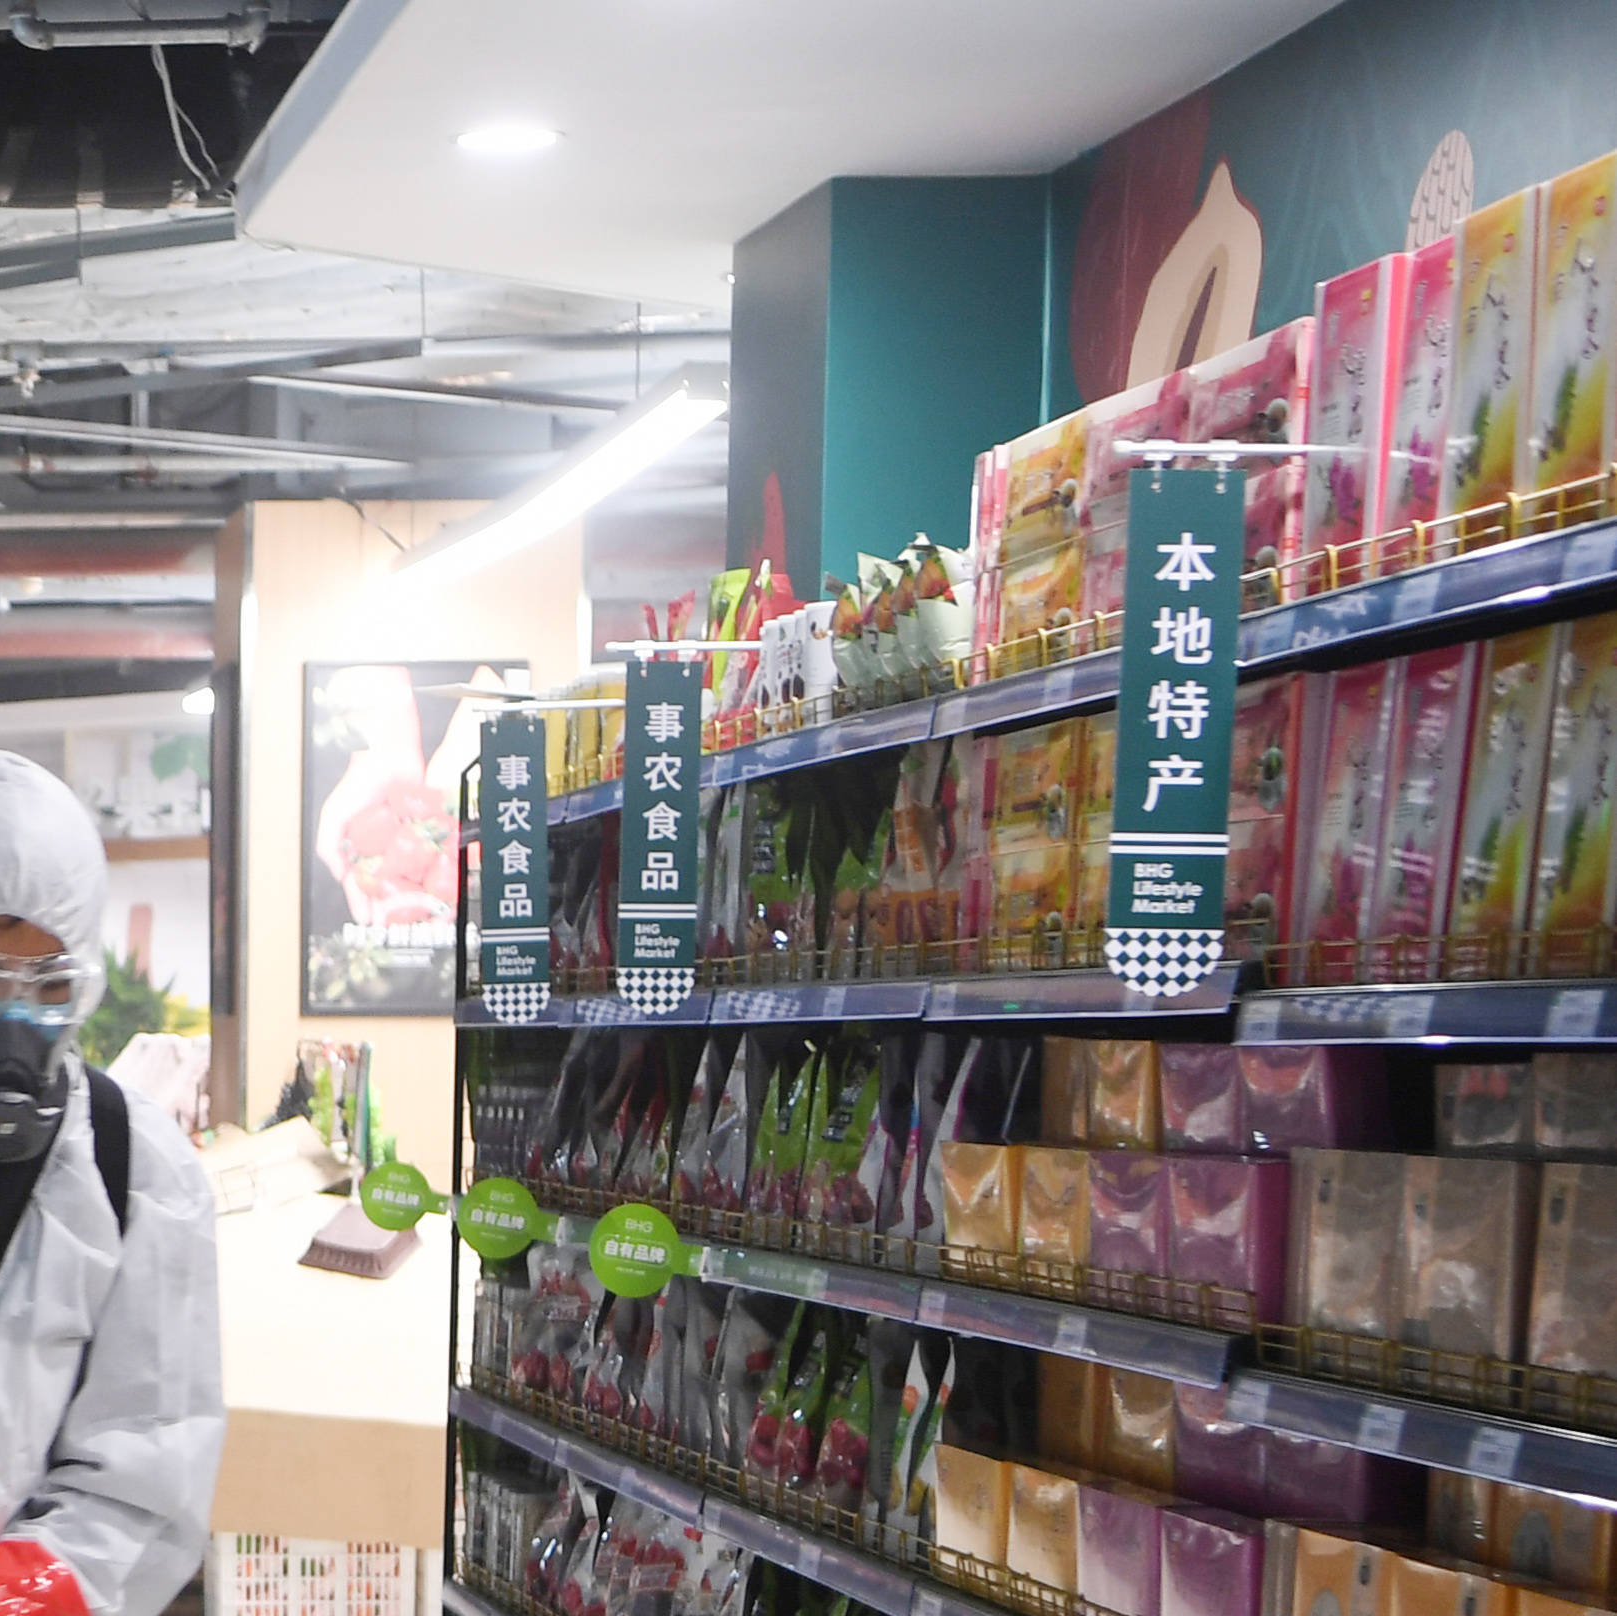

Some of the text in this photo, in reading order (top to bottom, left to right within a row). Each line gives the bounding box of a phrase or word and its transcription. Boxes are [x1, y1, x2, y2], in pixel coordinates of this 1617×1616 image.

[1140, 531, 1217, 813] 本地特产
[639, 701, 685, 892] 事农食品
[495, 754, 534, 919] 事农食品
[1133, 862, 1175, 879] BHG
[1133, 879, 1204, 901] Lifestyle
[1132, 896, 1196, 915] Market
[634, 922, 661, 936] BHG
[495, 945, 519, 956] BHG
[634, 935, 681, 950] Lifestyle
[495, 955, 537, 968] Lifestyle
[634, 946, 676, 959] Market
[495, 965, 533, 977] Market
[371, 1186, 421, 1207] 自有品牌
[470, 1207, 526, 1231] 自有品牌
[624, 1217, 654, 1234] BHG
[603, 1240, 667, 1265] 自有品牌
